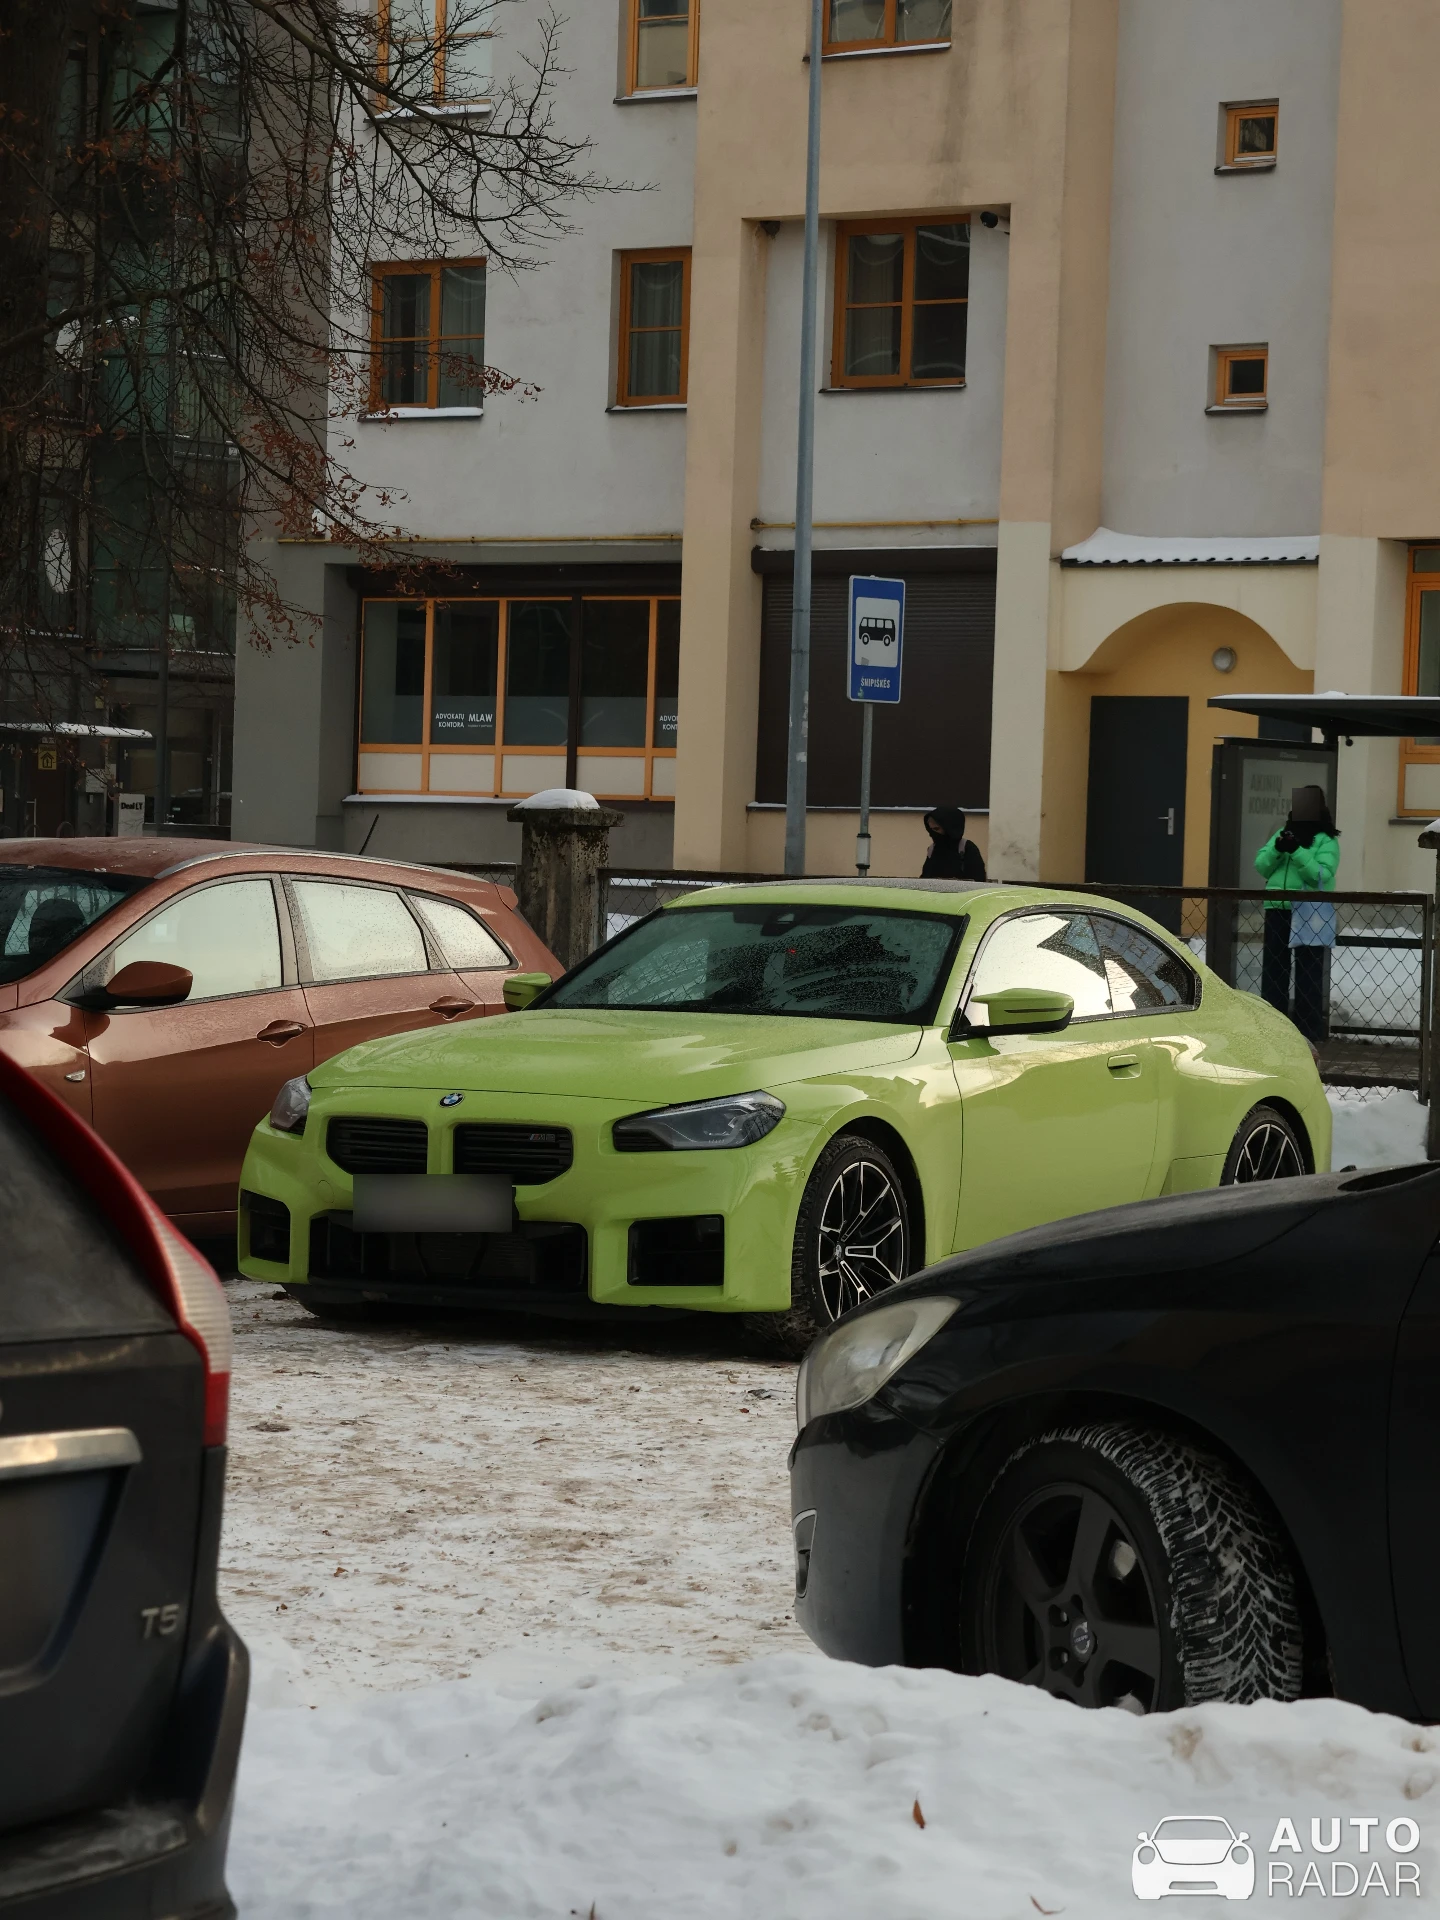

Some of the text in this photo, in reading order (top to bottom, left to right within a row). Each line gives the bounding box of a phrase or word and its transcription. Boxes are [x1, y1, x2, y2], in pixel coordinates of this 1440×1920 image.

[860, 676, 891, 688] ŠNIPIŠKĖS
[435, 713, 493, 722] ADVOKATŲ MLAW
[141, 1604, 180, 1639] T5
